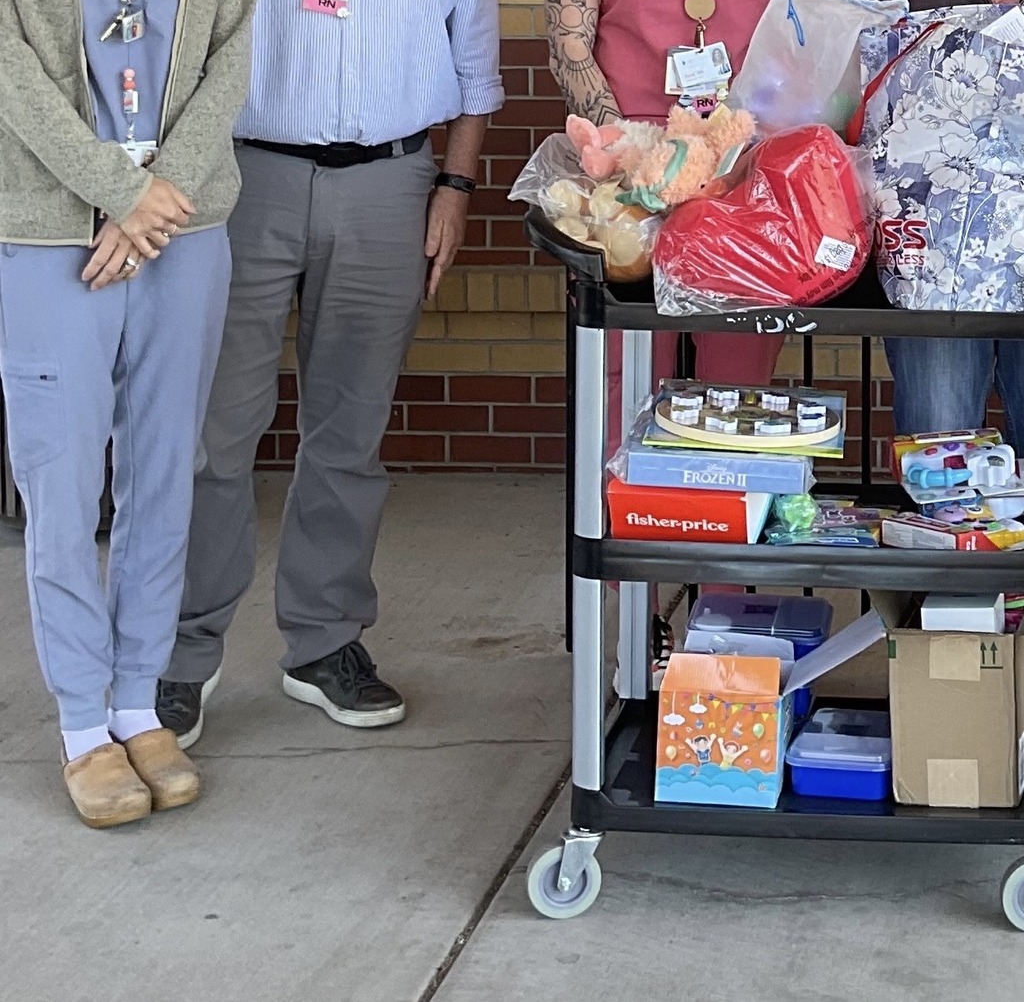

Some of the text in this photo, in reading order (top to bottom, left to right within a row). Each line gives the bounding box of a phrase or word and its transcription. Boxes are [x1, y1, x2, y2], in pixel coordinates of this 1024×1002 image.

[697, 98, 714, 108] RN
[896, 254, 925, 266] LESS
[683, 470, 747, 487] FROZEN II
[625, 512, 729, 532] fisher-price
